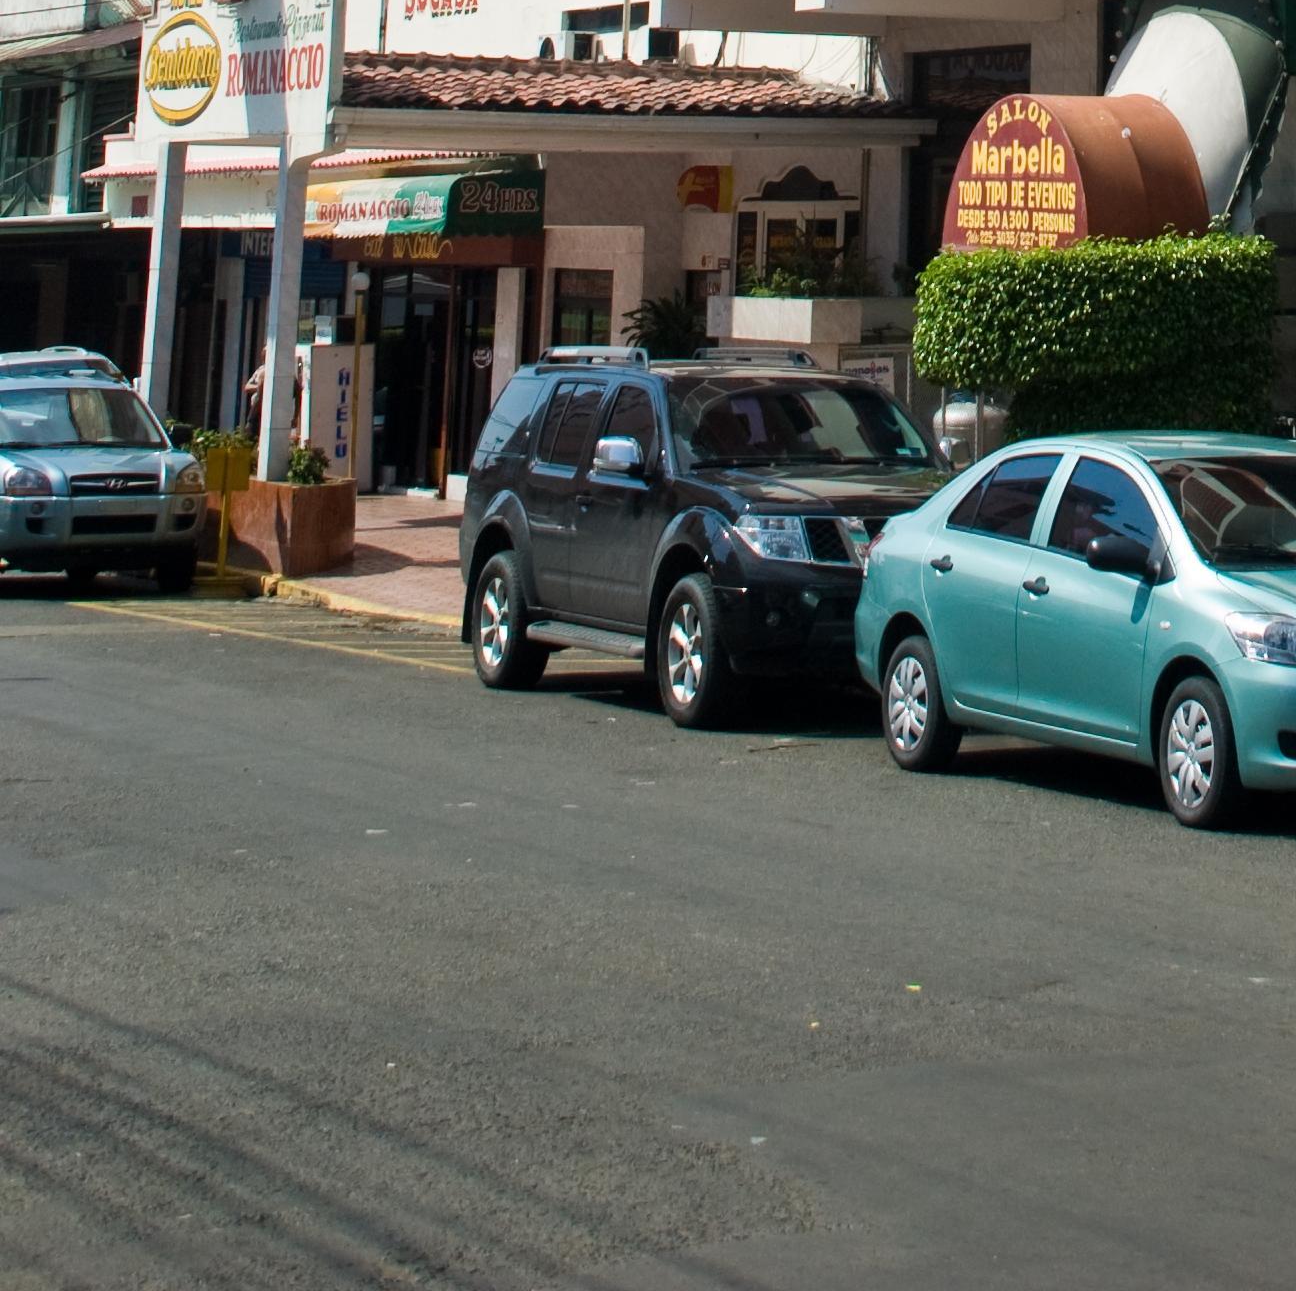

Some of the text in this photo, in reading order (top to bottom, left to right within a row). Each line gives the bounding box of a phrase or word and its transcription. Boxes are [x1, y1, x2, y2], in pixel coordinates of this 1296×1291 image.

[145, 37, 221, 91] Benidorm
[225, 42, 325, 97] ROMANACCIO
[986, 99, 1052, 138] SALON
[971, 137, 1066, 175] Marbella
[319, 198, 411, 224] ROMANACCIO
[958, 180, 1076, 210] TODO TIPO DE EVENTOS
[957, 209, 986, 228] DESDE
[987, 210, 1001, 229] 50
[1032, 211, 1076, 234] PERSONAS
